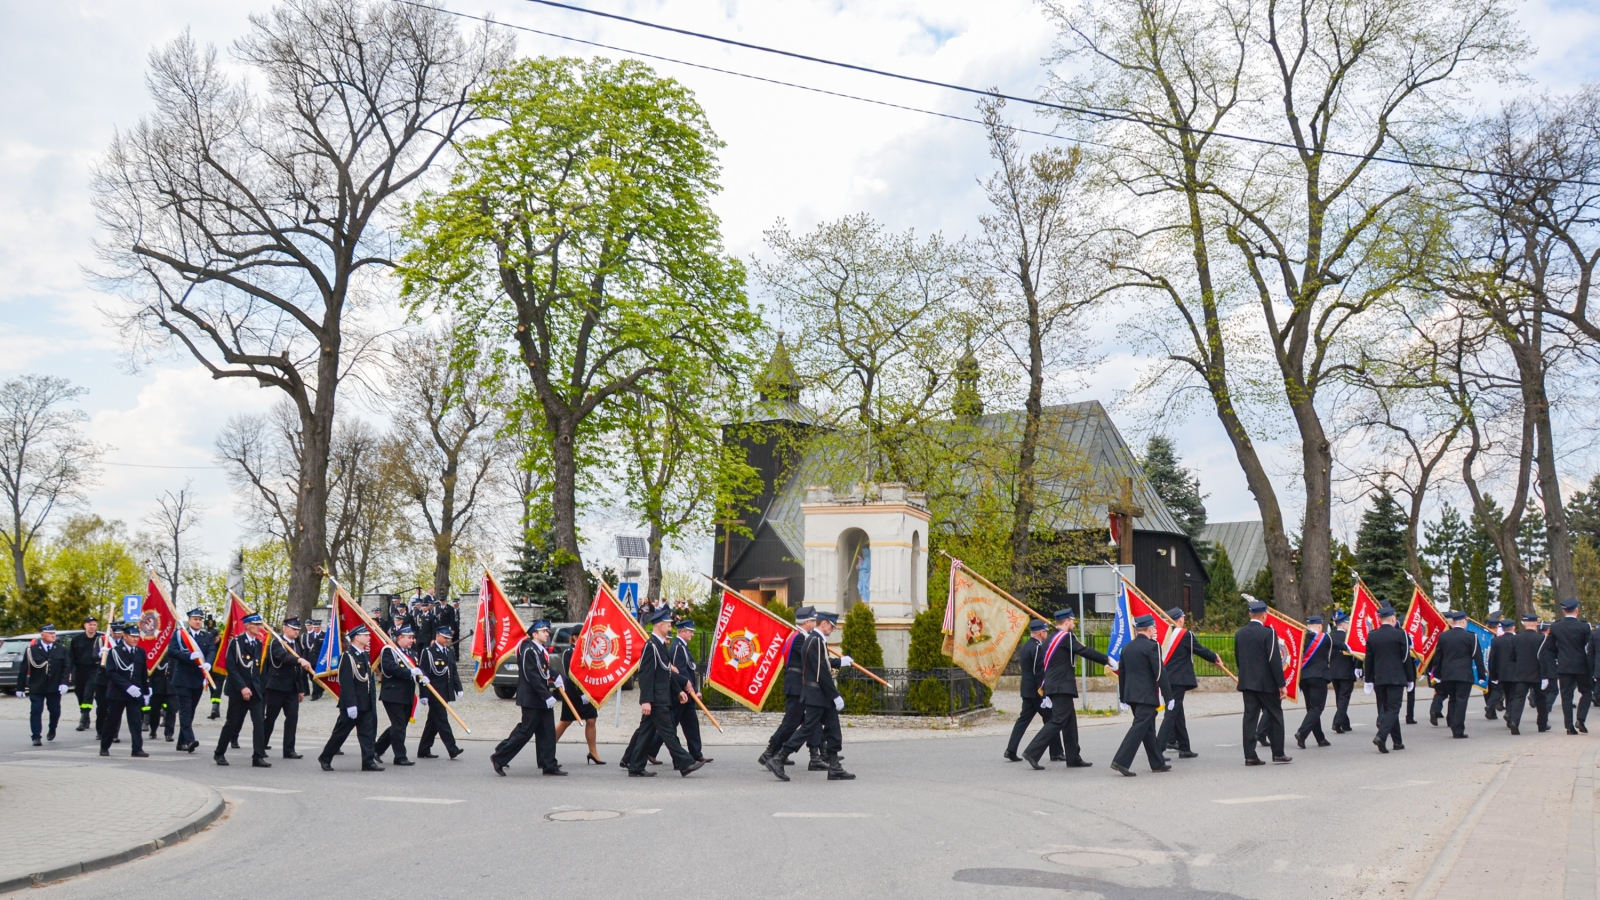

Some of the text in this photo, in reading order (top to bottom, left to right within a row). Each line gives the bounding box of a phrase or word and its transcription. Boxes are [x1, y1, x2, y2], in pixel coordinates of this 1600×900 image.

[127, 597, 138, 615] P
[1356, 618, 1363, 628] NA
[584, 628, 633, 686] LUDZIOM NA RATUNEK
[748, 632, 785, 695] OJCZYZNY
